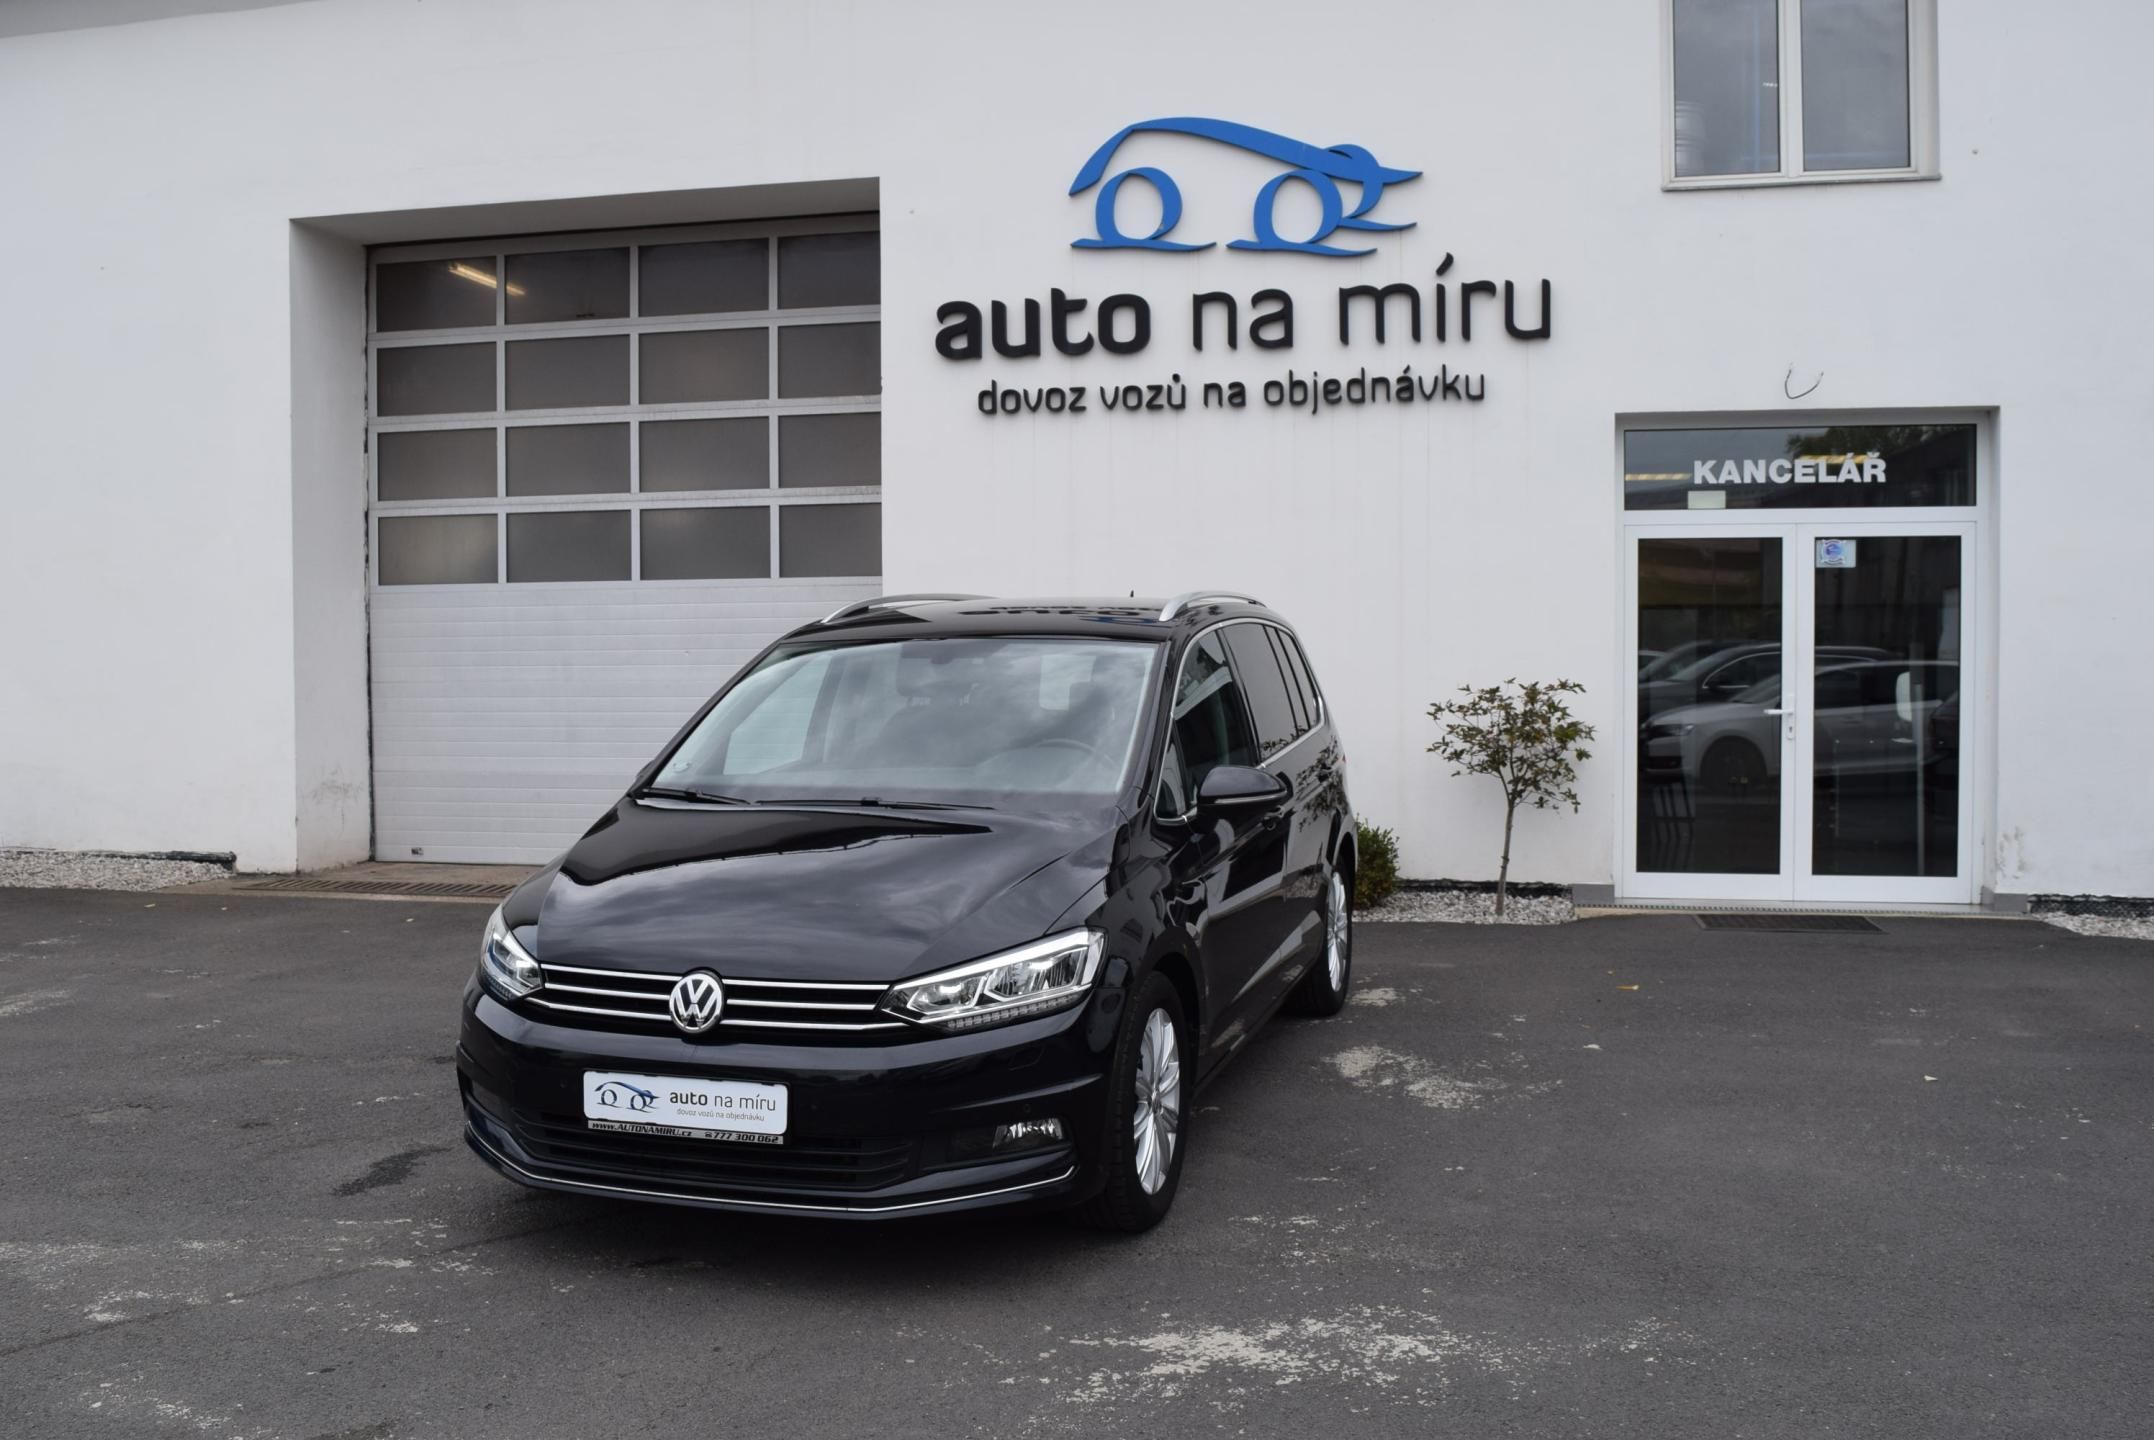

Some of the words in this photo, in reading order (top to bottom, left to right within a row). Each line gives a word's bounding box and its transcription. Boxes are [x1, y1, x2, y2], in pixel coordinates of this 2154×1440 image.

[935, 287, 1151, 360] auto
[1192, 287, 1294, 351] na
[1339, 252, 1551, 345] míru
[977, 379, 1087, 415] dovoz
[1099, 373, 1187, 411] vozů
[1203, 380, 1247, 409] na
[1263, 364, 1486, 414] objednávku
[1693, 451, 1887, 485] KANCELÁŘ
[669, 1091, 708, 1106] auto
[714, 1095, 733, 1108] na
[739, 1093, 776, 1111] míru
[676, 1108, 697, 1117] dovoz
[698, 1110, 714, 1118] vozů
[726, 1112, 765, 1122] objednávku
[735, 1133, 755, 1142] 300
[757, 1135, 779, 1143] 062
